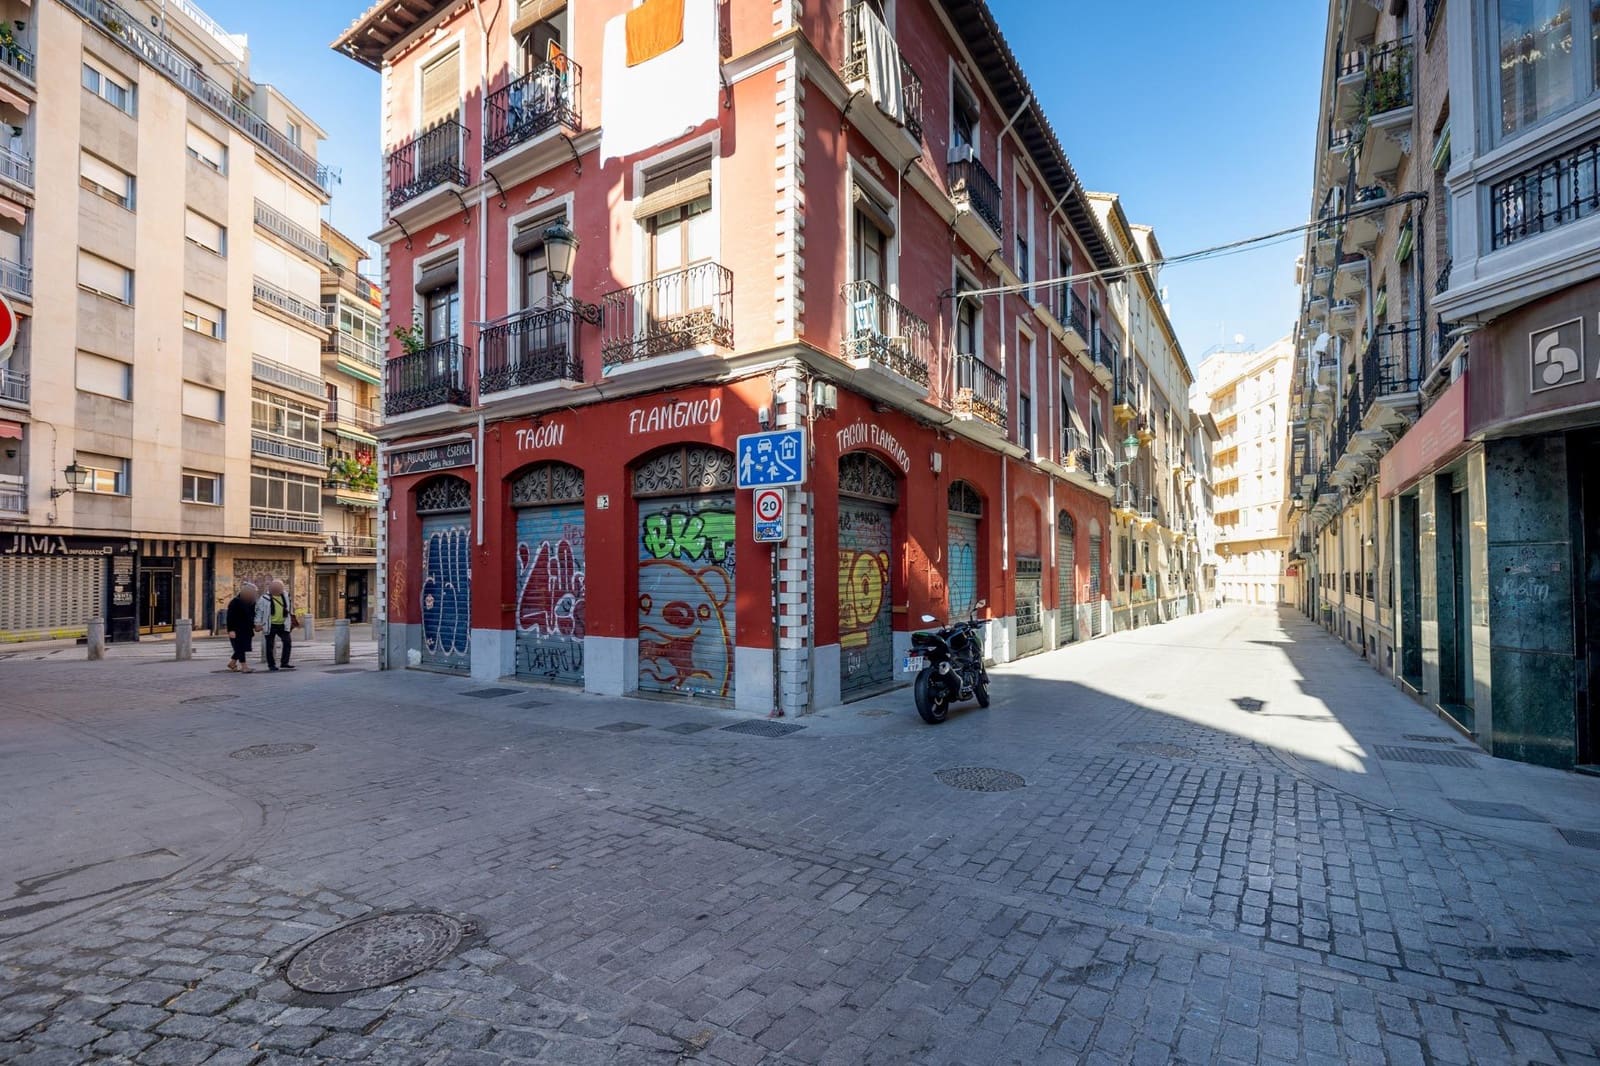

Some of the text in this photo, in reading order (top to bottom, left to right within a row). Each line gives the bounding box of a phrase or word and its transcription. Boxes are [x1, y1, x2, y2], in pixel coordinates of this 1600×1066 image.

[629, 398, 721, 434] FLAMENCO
[515, 420, 564, 451] TACÓN
[837, 417, 910, 473] TACÓN FLAMENCO
[762, 501, 777, 511] 20
[5, 535, 69, 554] JIMA
